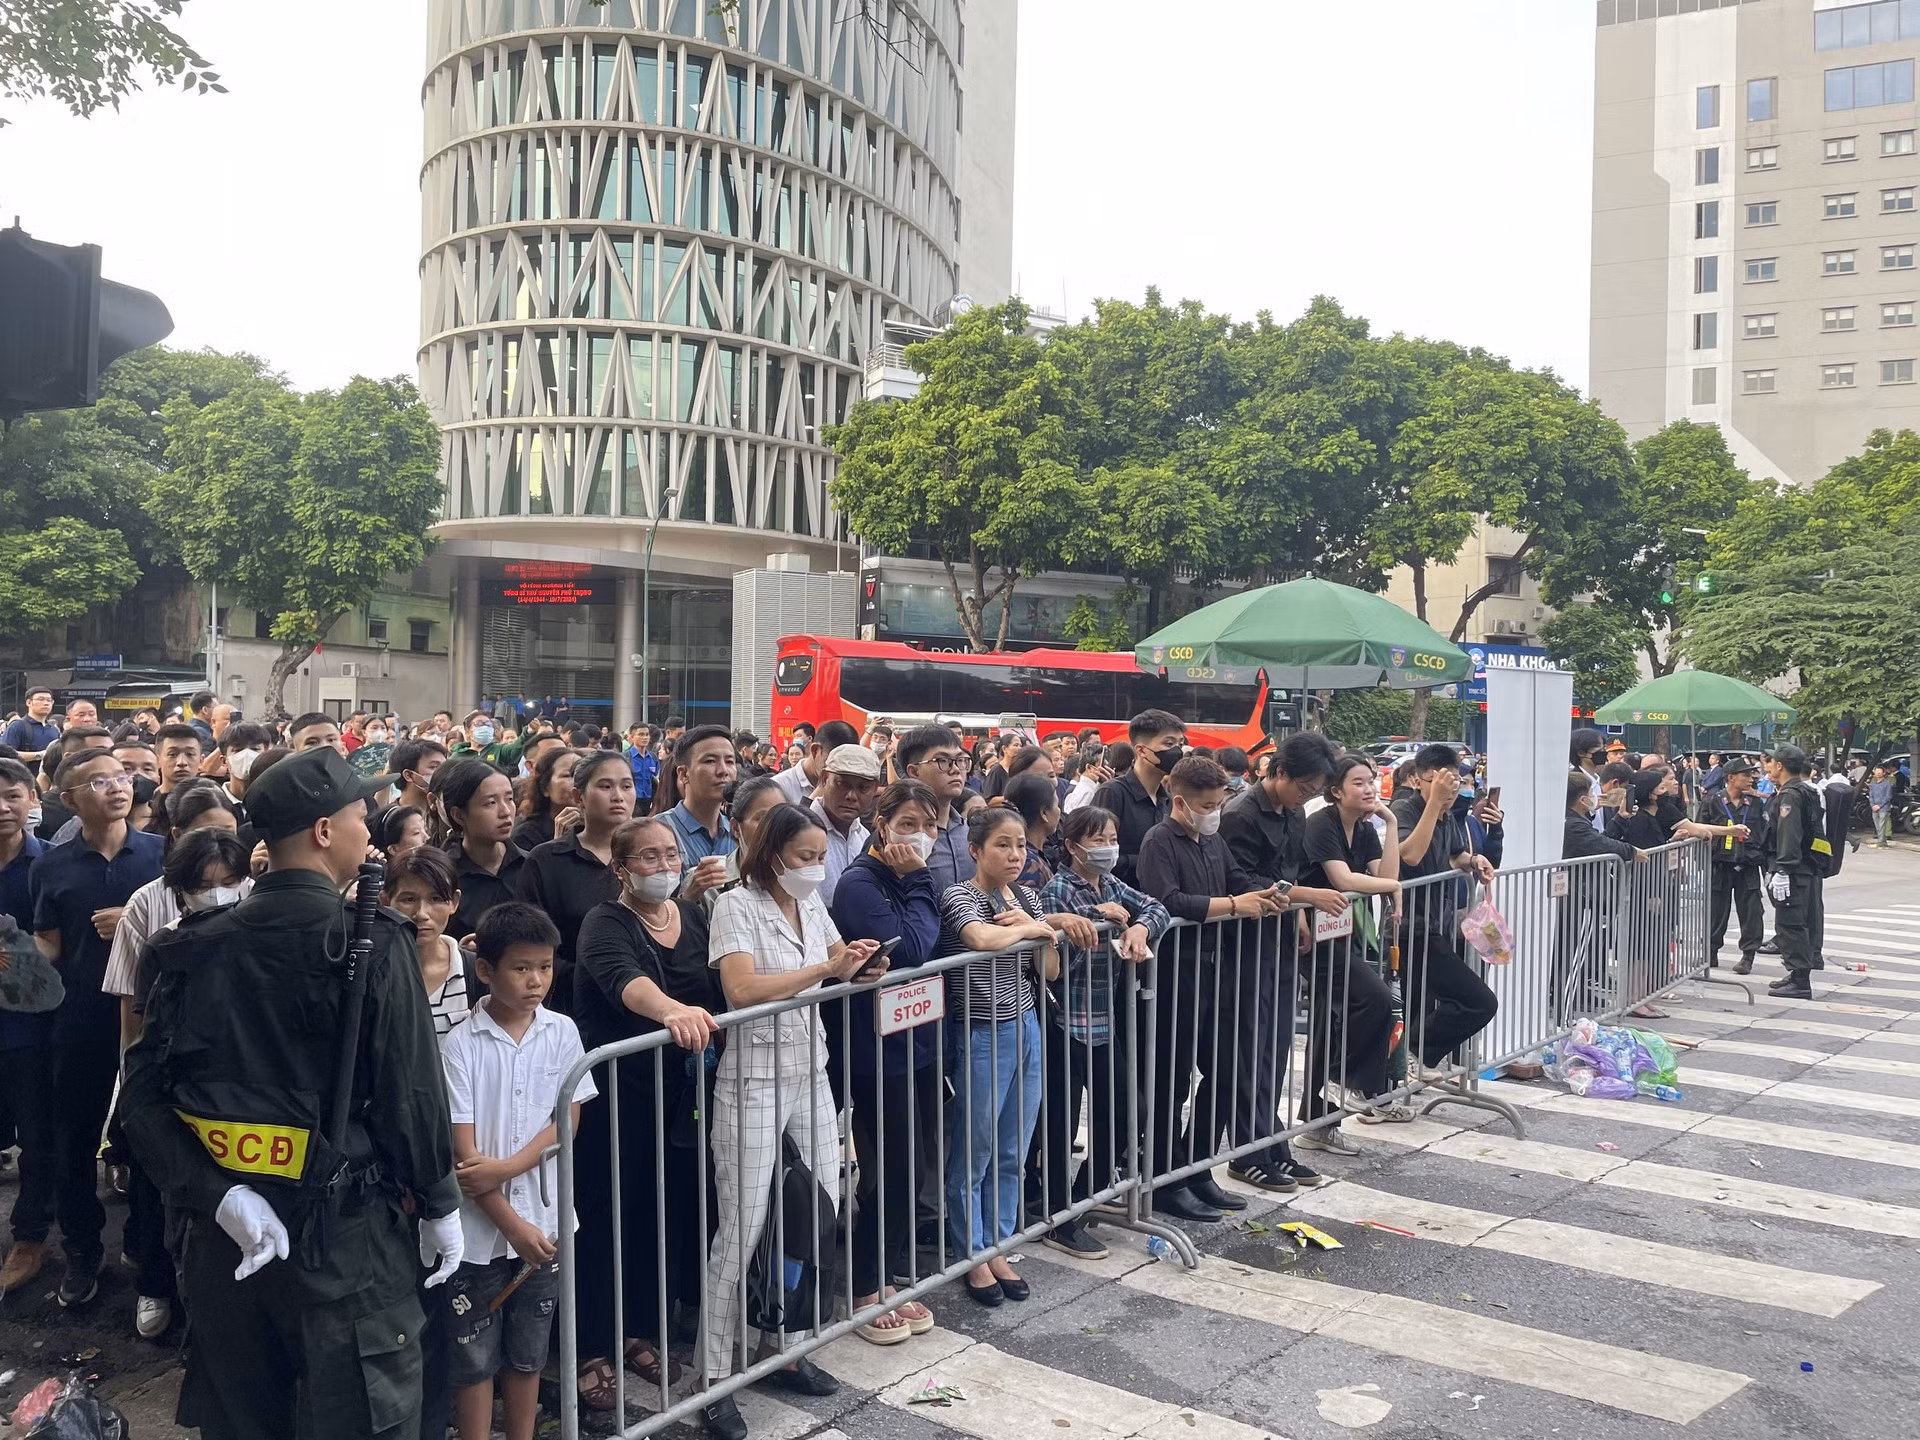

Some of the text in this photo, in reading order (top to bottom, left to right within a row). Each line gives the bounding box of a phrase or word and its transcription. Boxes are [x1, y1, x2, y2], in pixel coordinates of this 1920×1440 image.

[1169, 646, 1193, 660] CSCĐ
[1413, 653, 1446, 671] CSCĐ
[1488, 652, 1517, 668] NHA
[1519, 654, 1556, 671] KHOA
[1647, 712, 1669, 721] CSCĐ
[897, 986, 927, 1000] POLICE
[893, 999, 931, 1022] STOP
[186, 1122, 294, 1166] SCĐ
